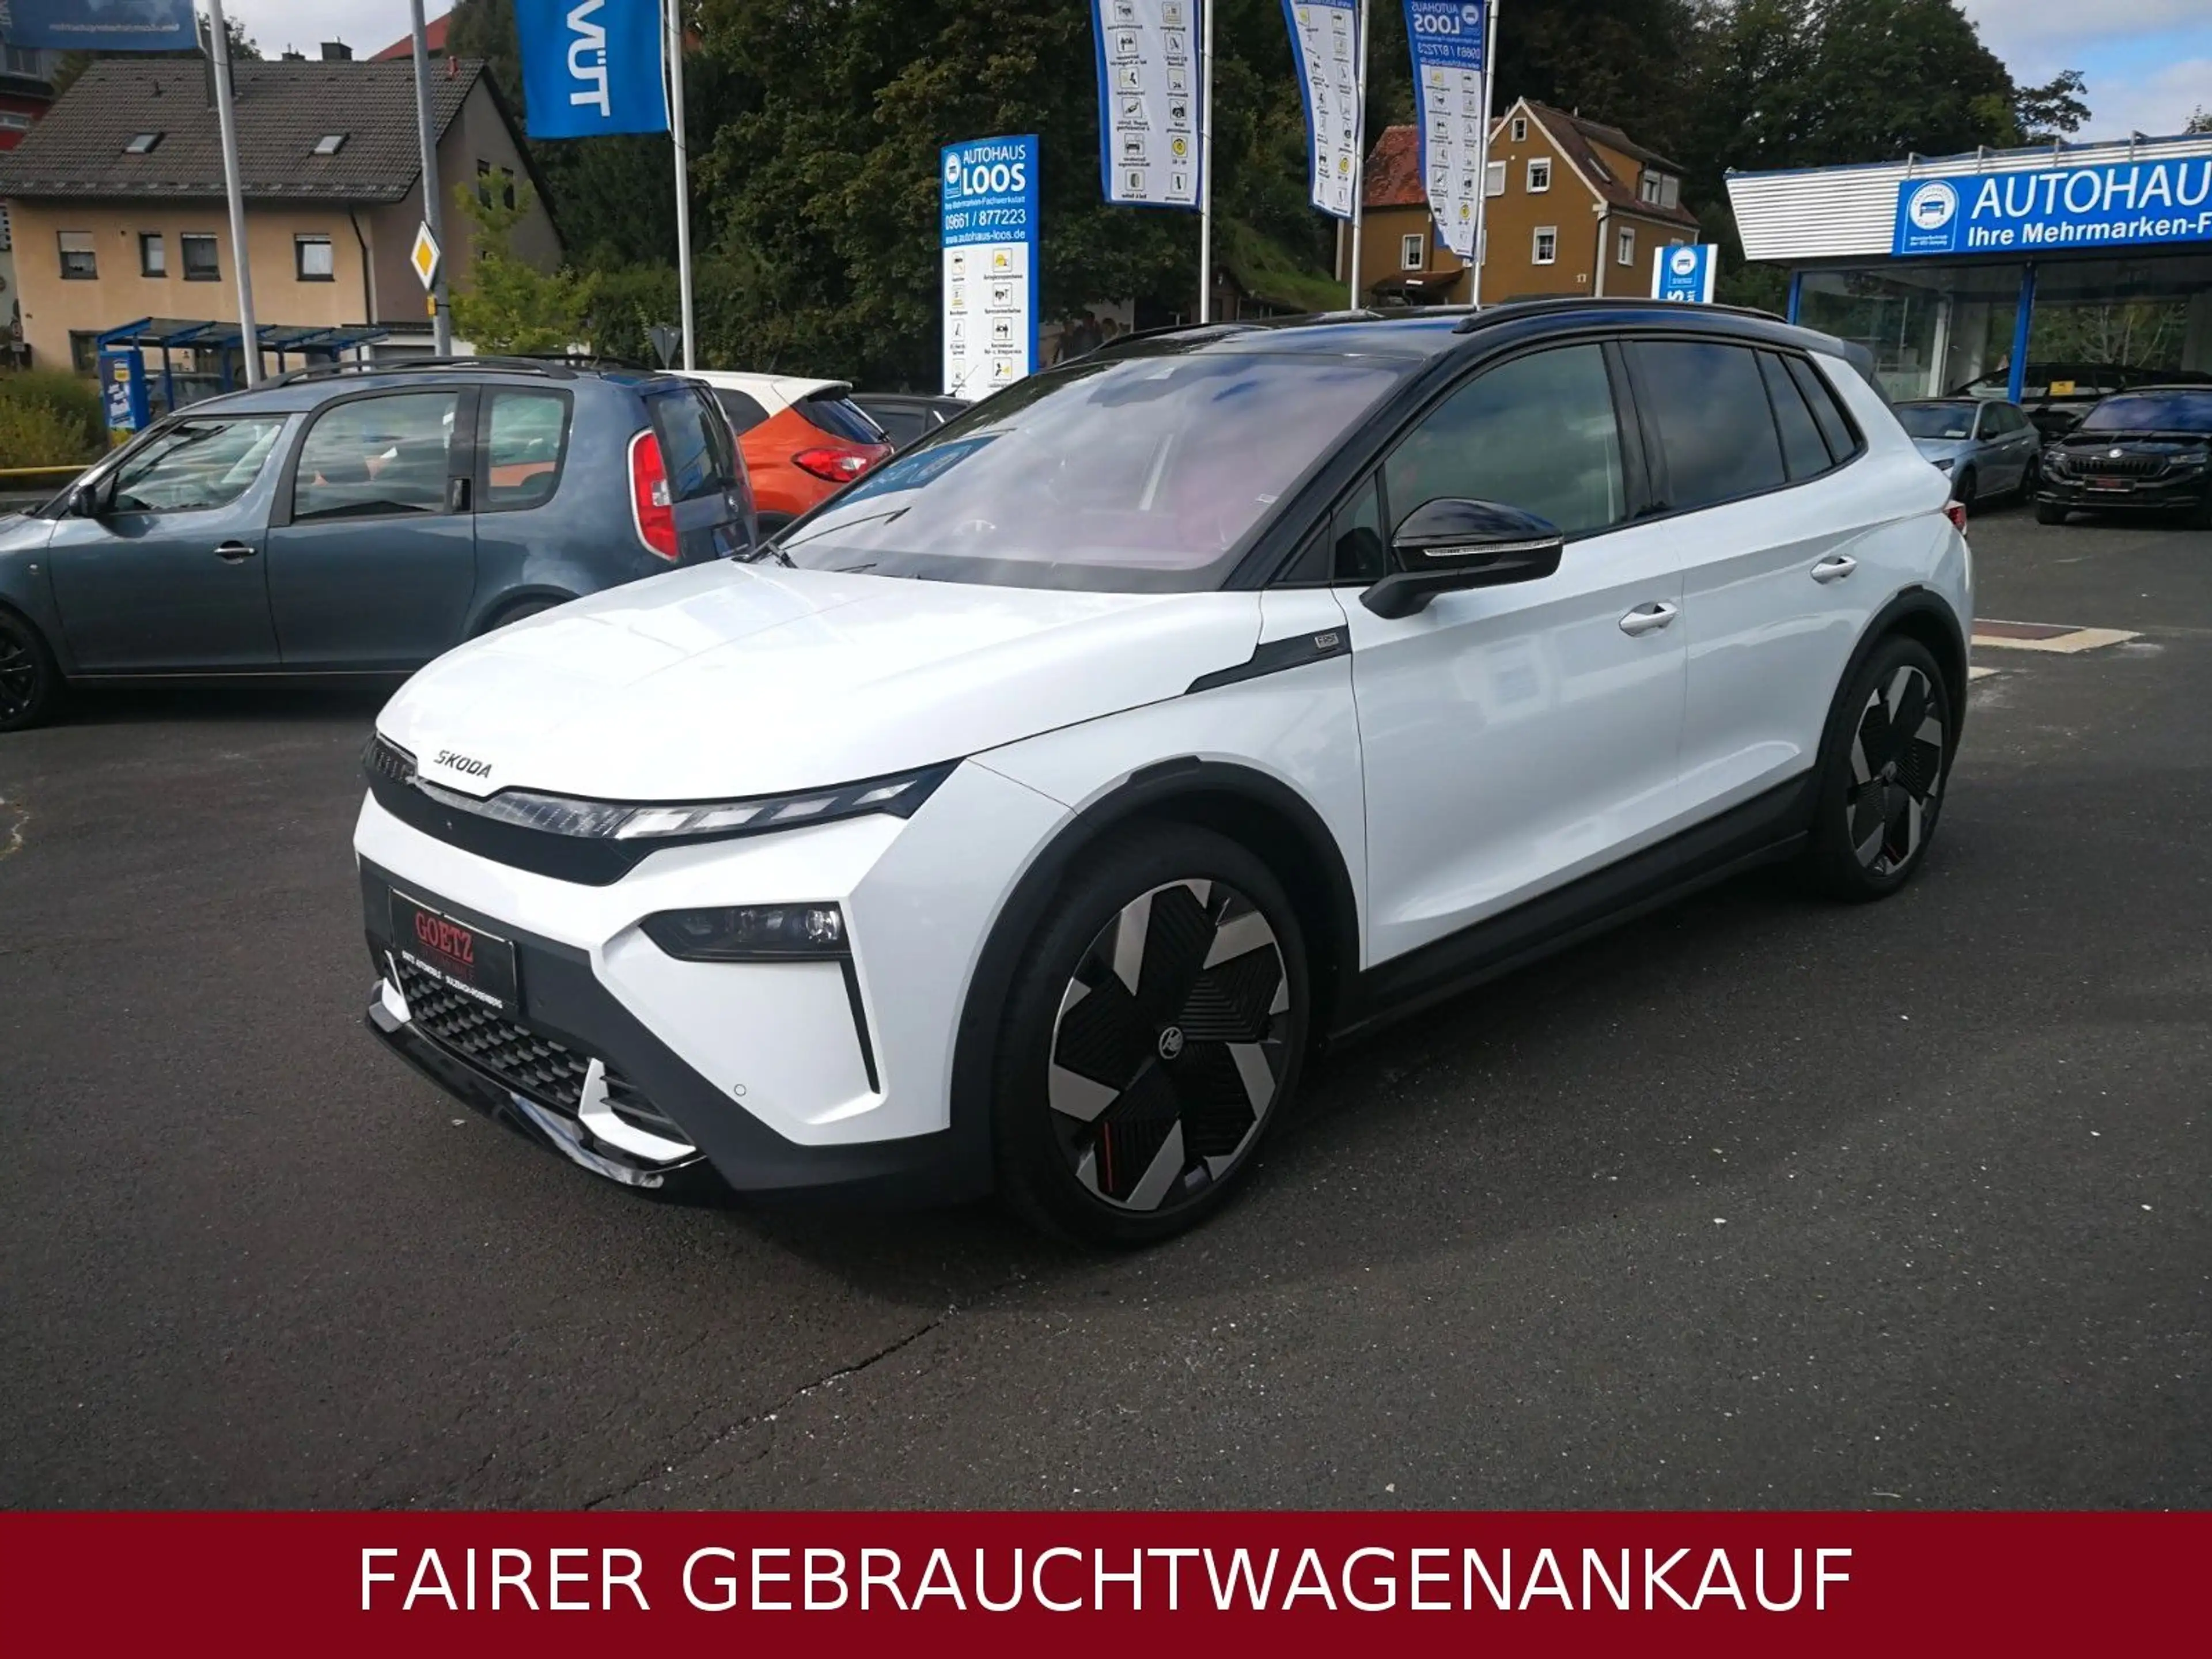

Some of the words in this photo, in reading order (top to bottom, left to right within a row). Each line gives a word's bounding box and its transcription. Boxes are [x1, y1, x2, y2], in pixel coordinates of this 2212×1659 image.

[963, 145, 1026, 164] AUTOHAUS
[963, 163, 1026, 196] LOOS
[1971, 161, 2212, 219] AUTOHAU
[945, 213, 969, 230] 09661
[972, 210, 977, 226] /
[979, 208, 1026, 226] 877223
[1968, 226, 2014, 247] Ihre
[415, 911, 474, 964] GOETZ
